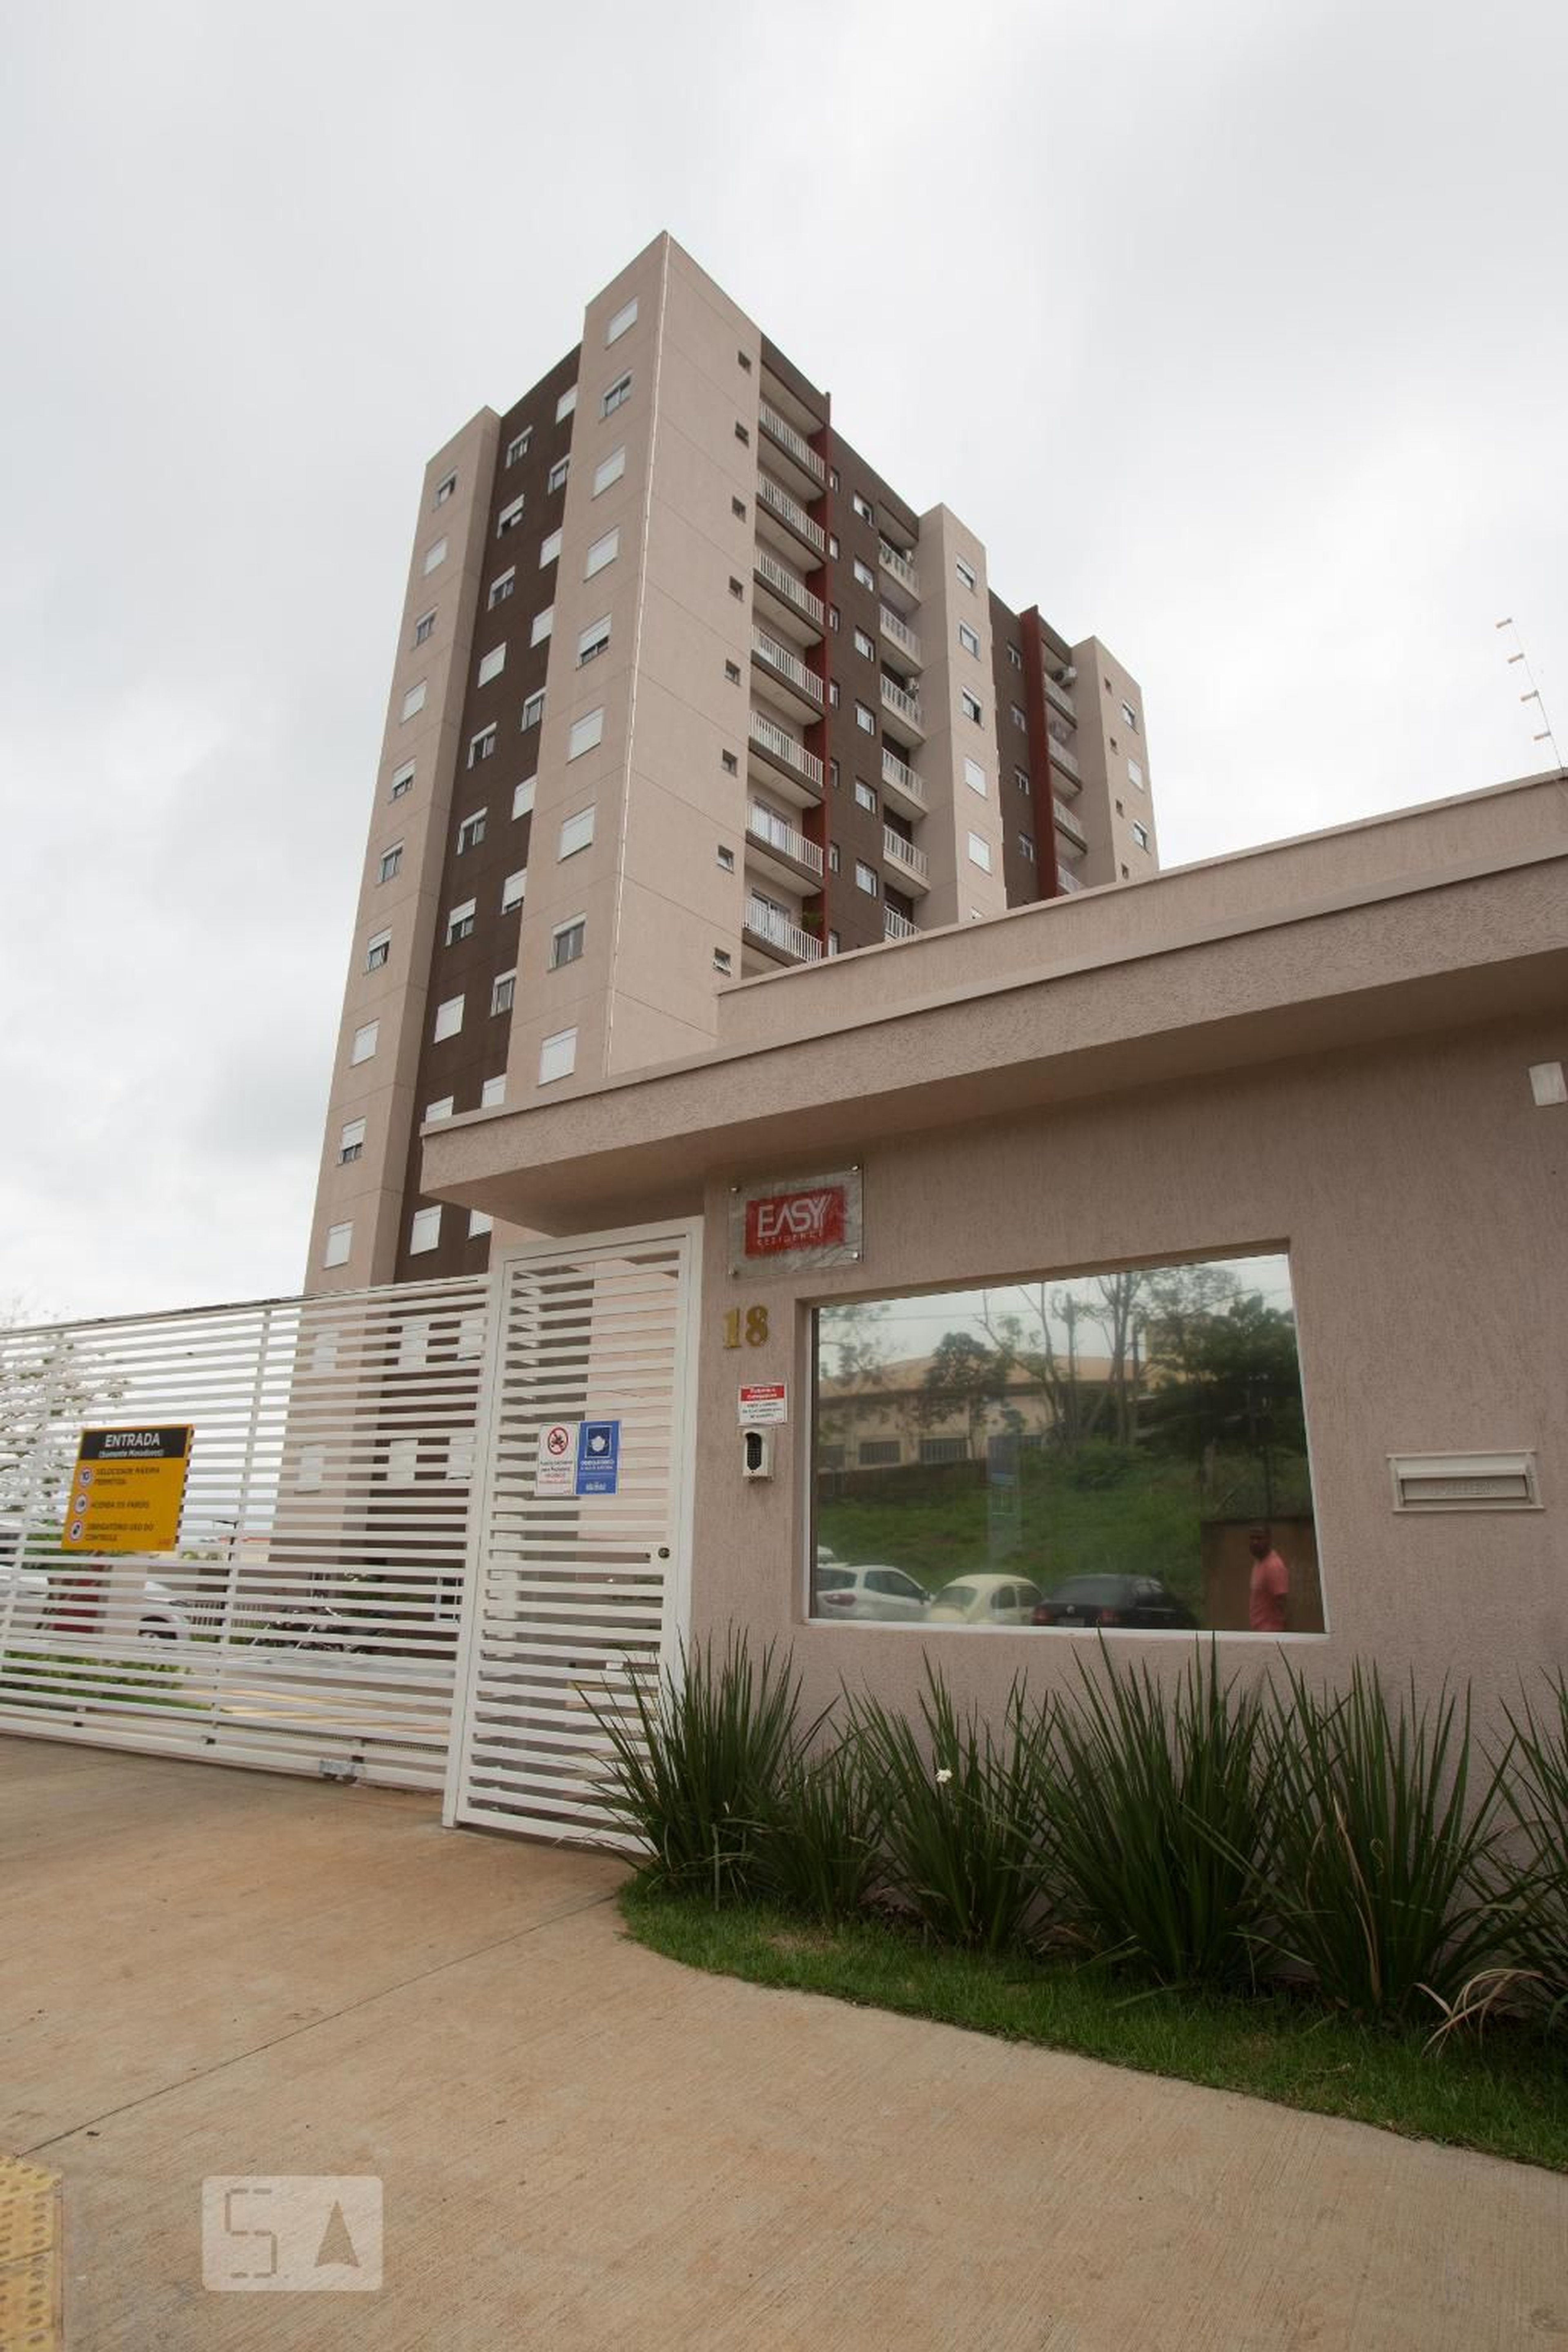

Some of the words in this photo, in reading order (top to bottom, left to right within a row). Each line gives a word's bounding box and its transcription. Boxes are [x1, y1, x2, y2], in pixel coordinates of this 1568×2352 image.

[757, 1193, 833, 1238] EASY
[723, 1305, 768, 1348] 18
[105, 1433, 160, 1447] ENTRADA
